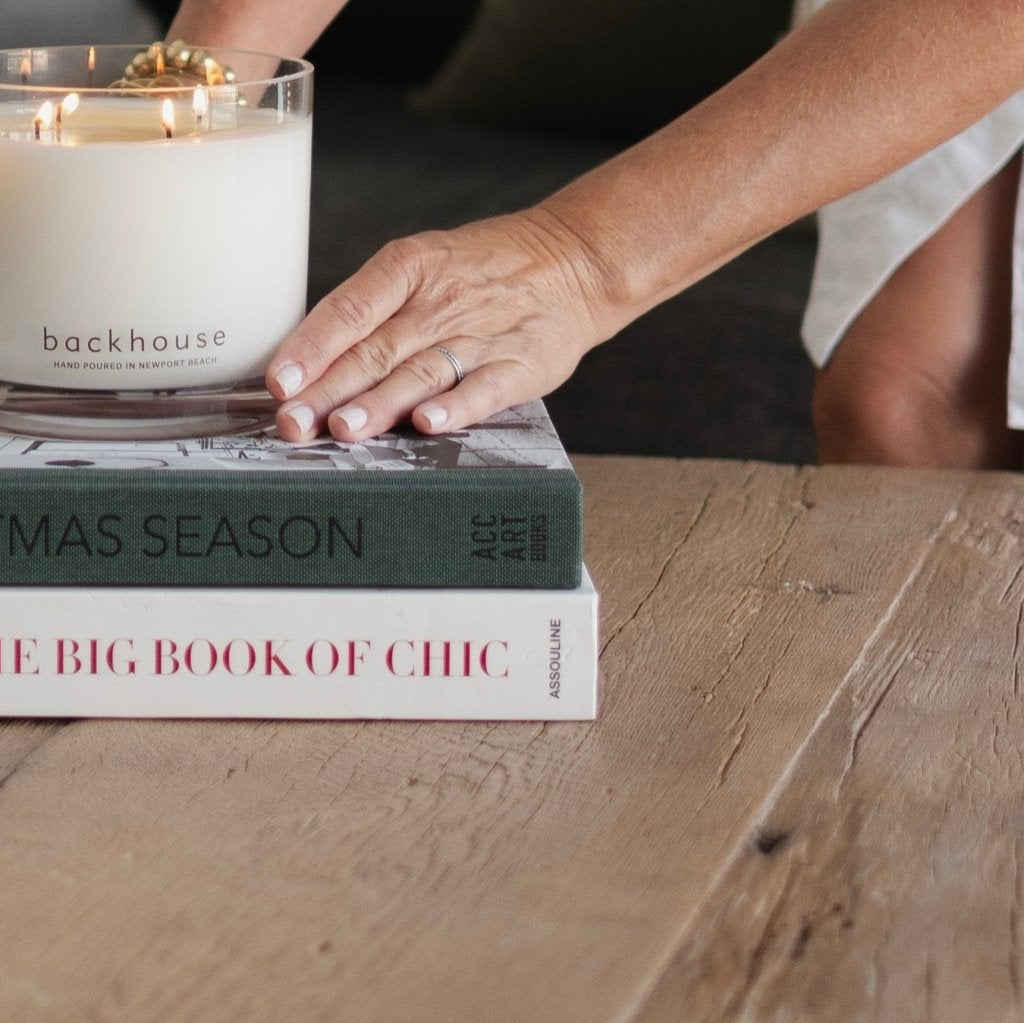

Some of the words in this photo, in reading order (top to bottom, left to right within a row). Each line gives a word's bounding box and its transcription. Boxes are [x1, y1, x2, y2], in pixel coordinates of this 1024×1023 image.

[43, 326, 226, 353] backhouse
[53, 361, 80, 370] HAND
[83, 362, 123, 371] POURED
[125, 362, 136, 370] IN
[138, 359, 185, 369] NEWPORT
[188, 356, 218, 367] BEACH
[142, 513, 364, 559] SEASON
[471, 513, 497, 562] ACC
[500, 514, 527, 562] ART
[530, 512, 548, 562] BOOKS
[52, 637, 141, 676] BIG
[150, 637, 297, 677] BOOK
[304, 638, 372, 677] OF
[384, 639, 509, 678] CHIC
[548, 618, 562, 700] ASSOULINE
